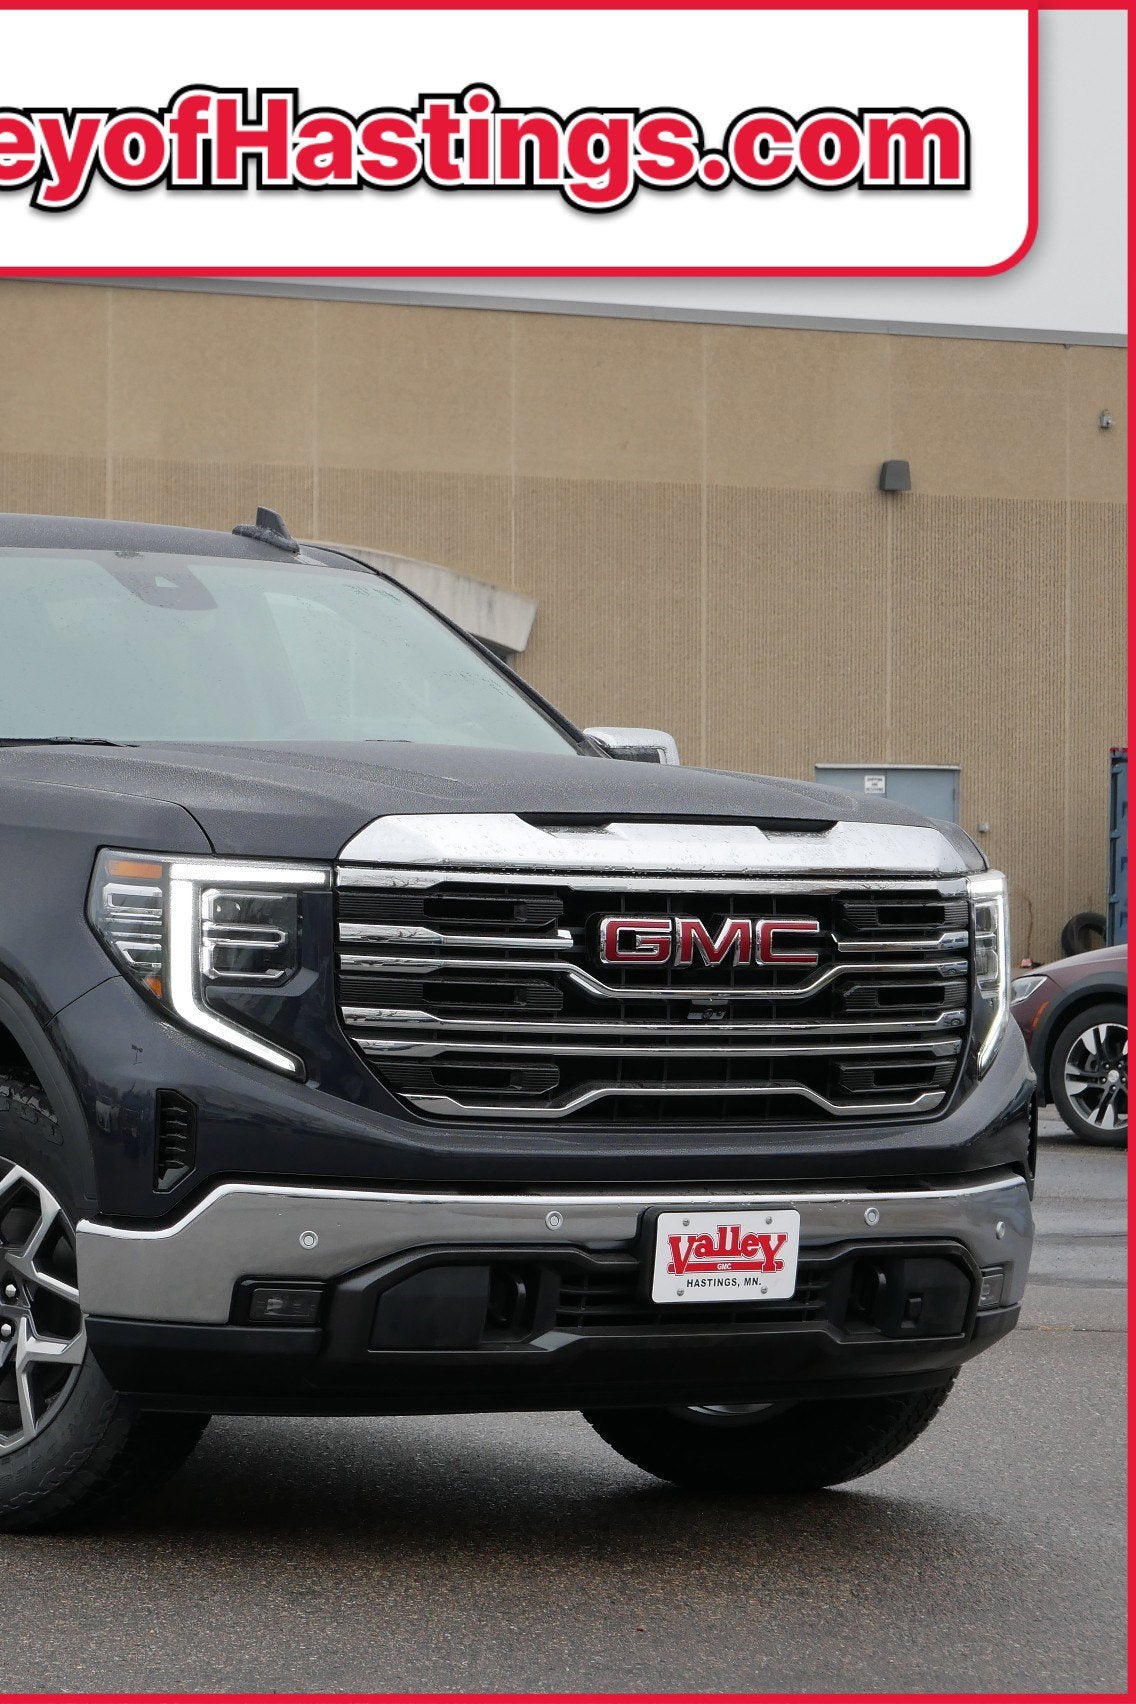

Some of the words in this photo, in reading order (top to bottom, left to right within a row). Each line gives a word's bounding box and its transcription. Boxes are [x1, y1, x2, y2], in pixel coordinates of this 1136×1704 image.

[600, 915, 819, 967] GMC
[716, 1262, 733, 1271] GMC
[686, 1277, 740, 1288] HASTINGS,
[743, 1277, 762, 1286] MN.
